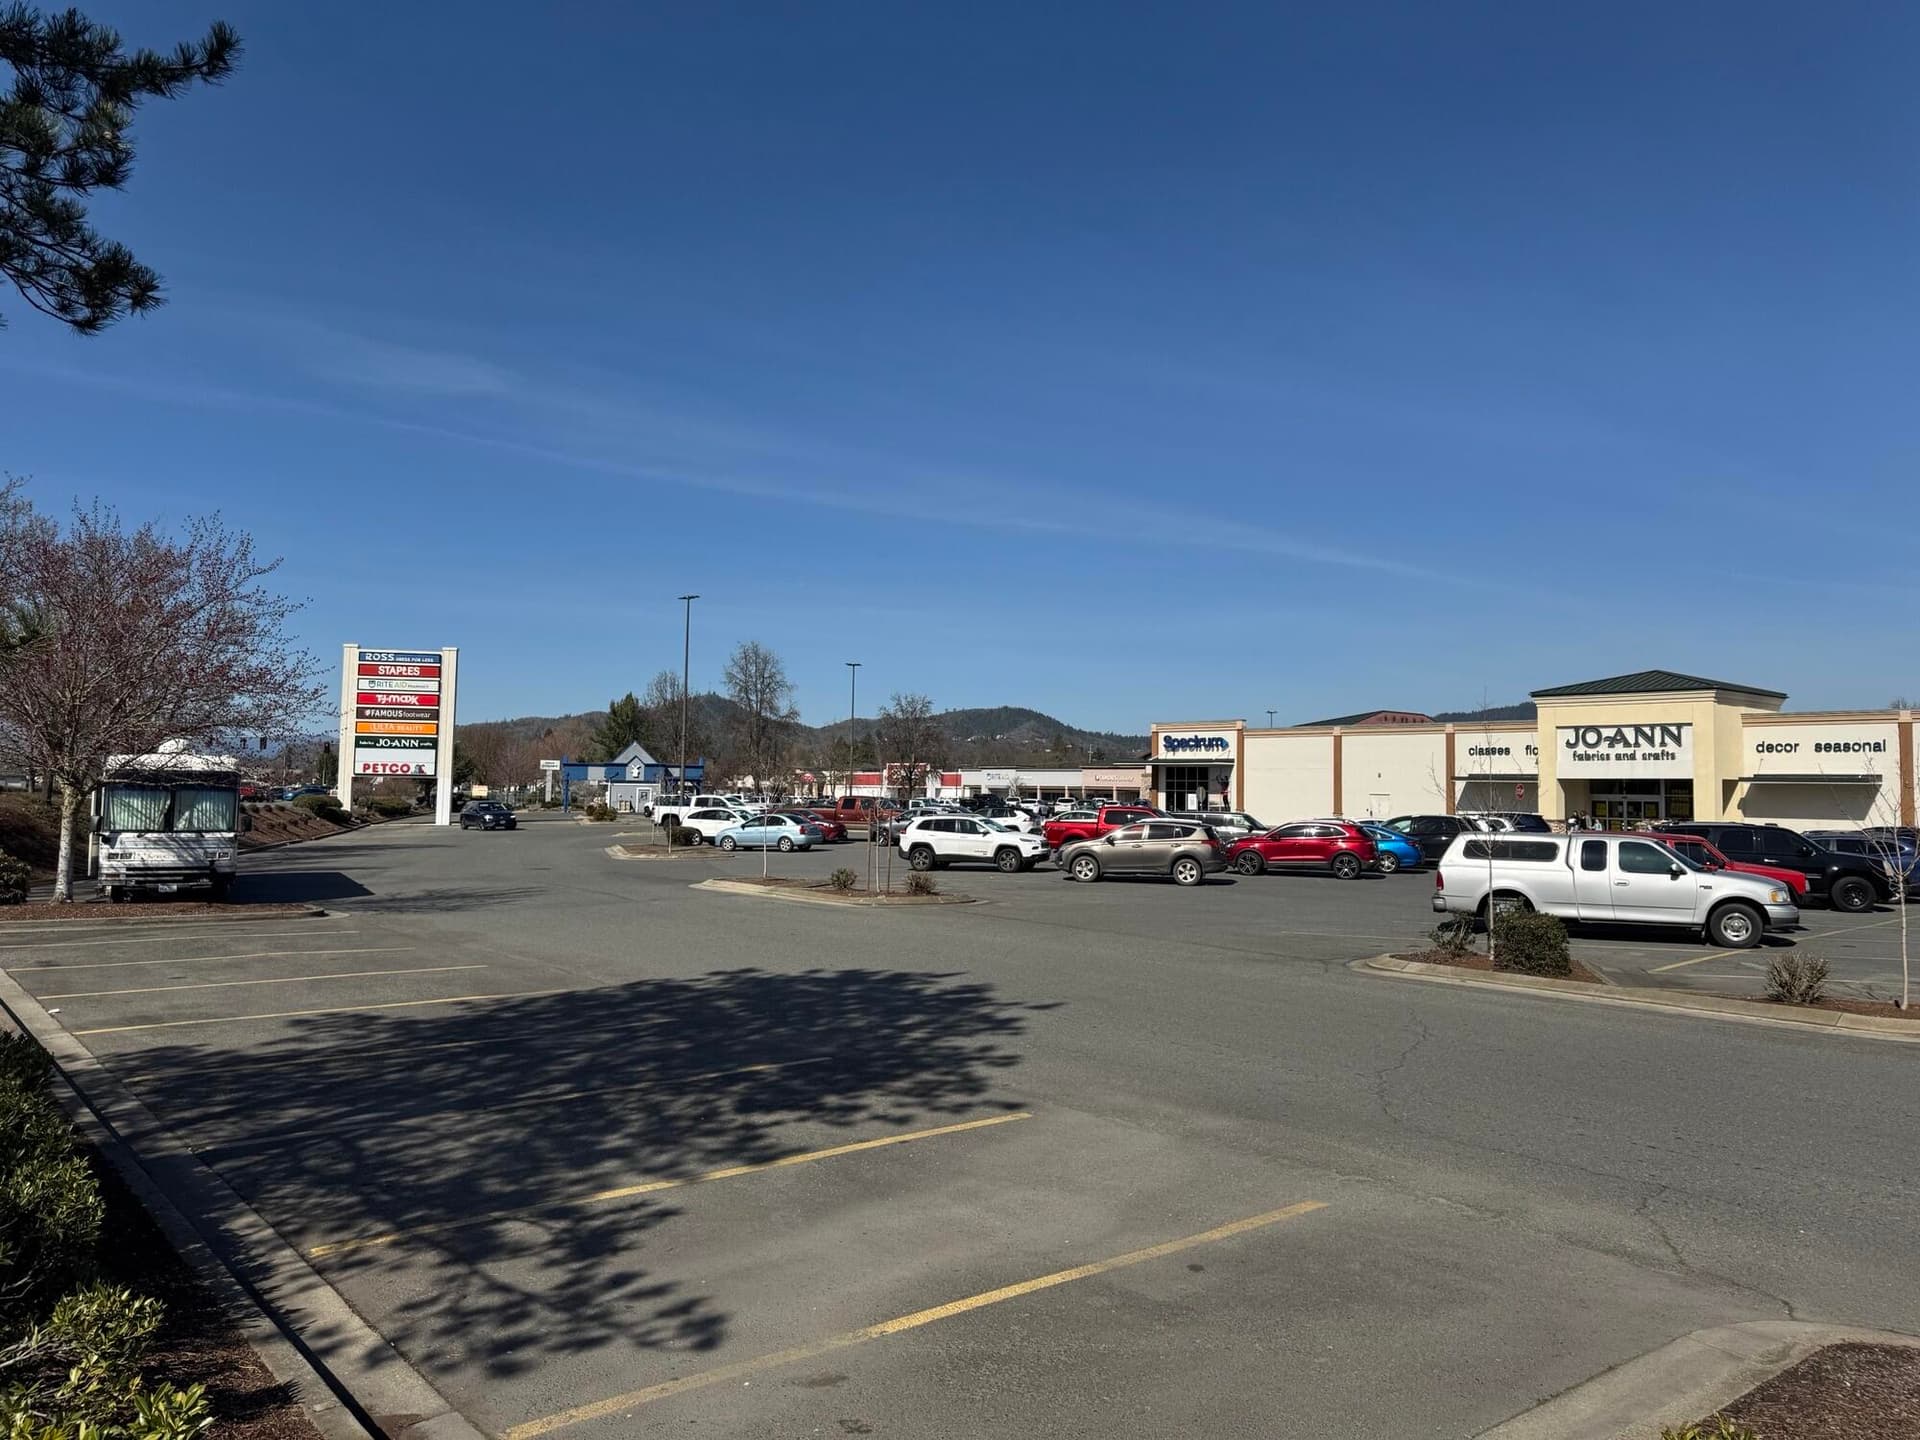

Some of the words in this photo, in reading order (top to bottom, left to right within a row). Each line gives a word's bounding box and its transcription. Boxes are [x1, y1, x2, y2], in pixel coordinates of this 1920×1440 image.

[365, 653, 395, 661] ROSS
[378, 665, 420, 676] STAPLES
[376, 681, 393, 689] RITE
[371, 709, 403, 718] FAMOUS
[403, 711, 431, 719] footwear
[1163, 735, 1223, 750] Spectrum
[1755, 740, 1800, 753] decor
[1814, 739, 1886, 753] seasonal
[1468, 745, 1511, 756] classes
[1572, 750, 1611, 761] fabrics
[1614, 750, 1637, 761] and
[1641, 749, 1676, 761] crafts
[363, 763, 411, 773] PETCO
